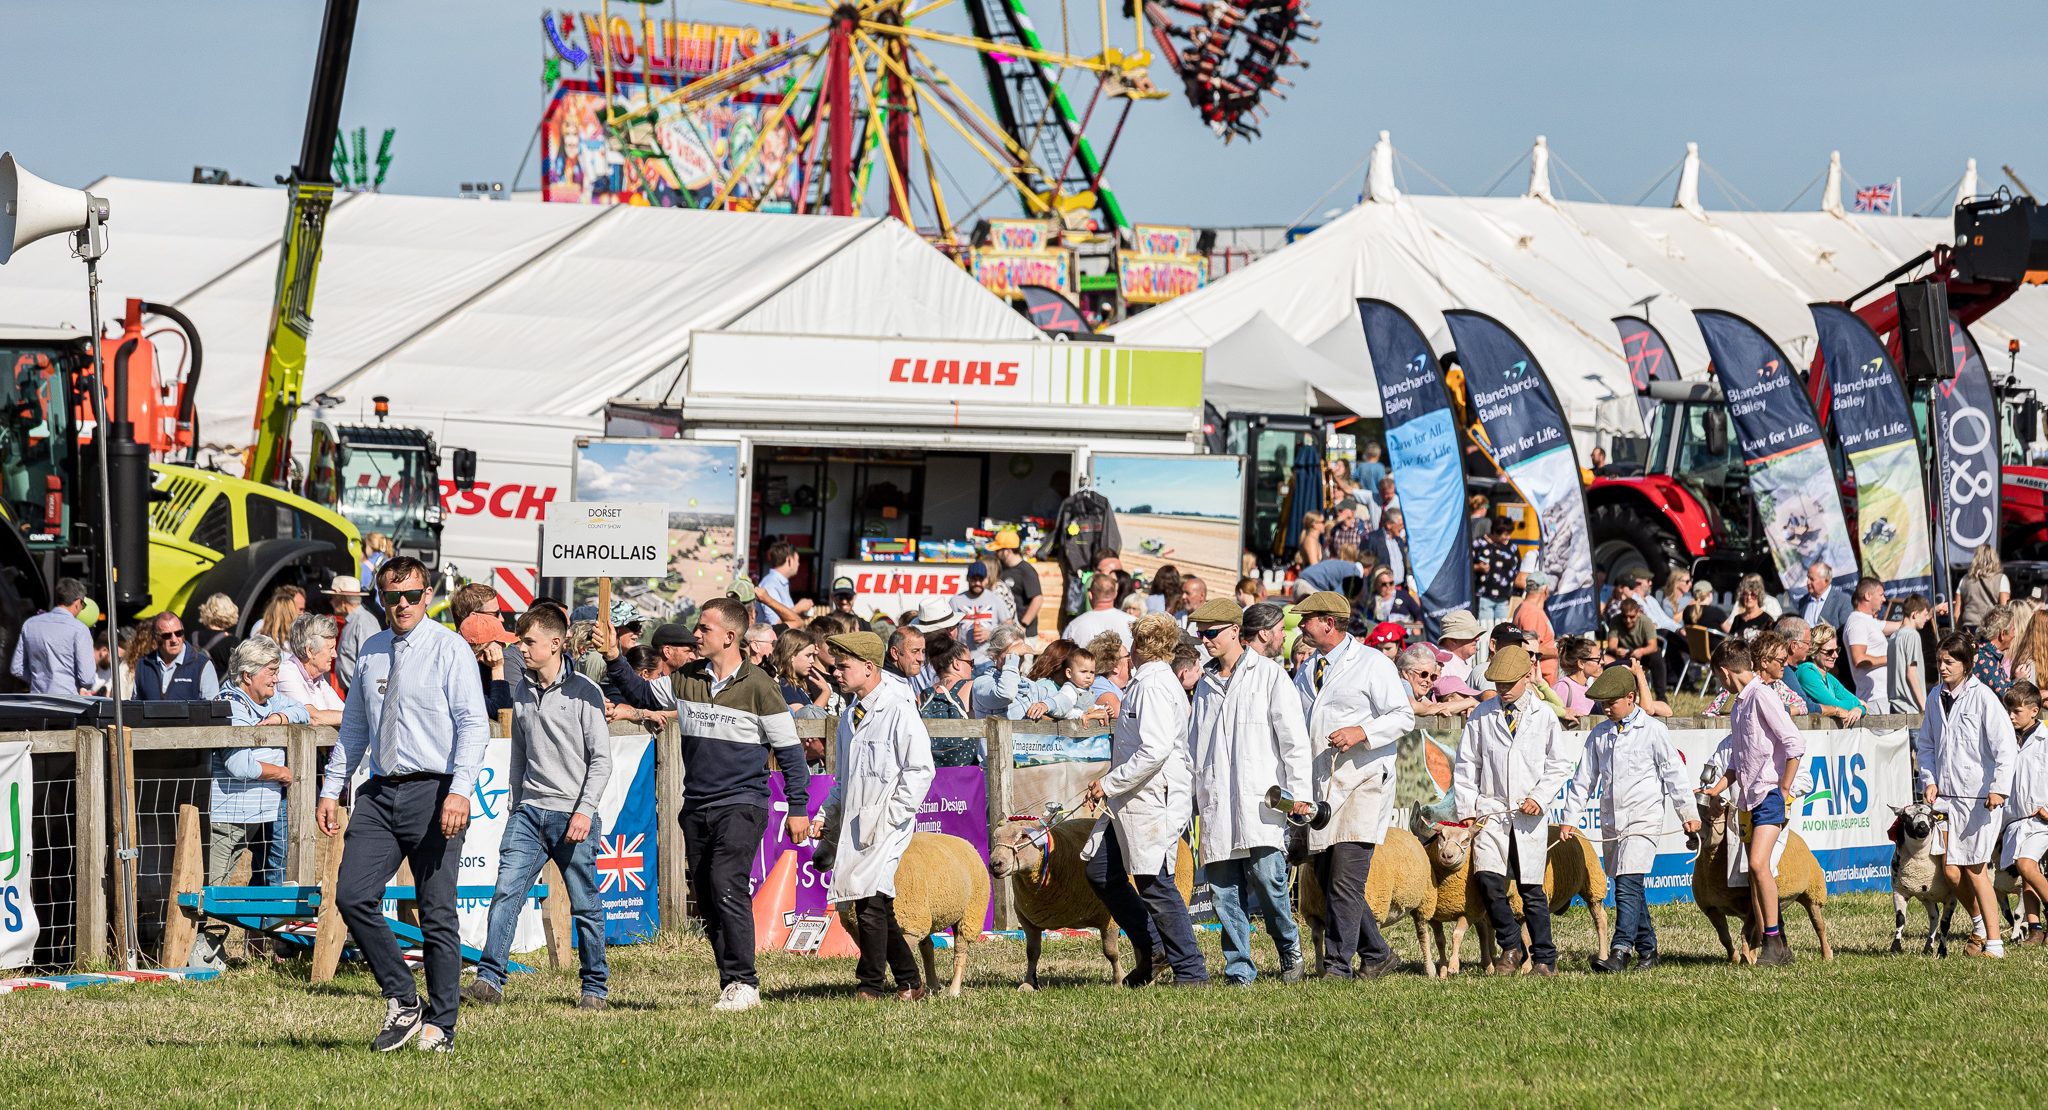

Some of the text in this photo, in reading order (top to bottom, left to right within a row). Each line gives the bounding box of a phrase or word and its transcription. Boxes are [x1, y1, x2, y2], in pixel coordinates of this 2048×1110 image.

[583, 13, 761, 72] NO-LIMITS
[889, 358, 1019, 386] CLAAS
[1474, 374, 1540, 407] Blanchards
[1727, 374, 1791, 403] Blanchards
[1385, 396, 1412, 415] Bailey
[1731, 400, 1767, 418] Bailey
[1833, 394, 1866, 411] Bailey
[1478, 402, 1513, 424] Bailey
[1519, 434, 1536, 451] for
[1537, 426, 1562, 444] Life.
[1742, 421, 1814, 452] Law for Life.
[1864, 427, 1880, 441] for
[1882, 421, 1908, 438] Life.
[1950, 406, 1993, 548] C&O
[2016, 476, 2048, 489] MASSEY
[588, 508, 622, 518] DORSET
[552, 544, 657, 561] CHAROLLAIS
[856, 573, 960, 595] CLAAS
[709, 713, 720, 721] OF
[720, 714, 737, 725] FIFE
[941, 797, 967, 816] Design
[1802, 819, 1828, 831] AVON
[601, 896, 644, 910] Supporting British
[606, 910, 640, 921] Manufacturing
